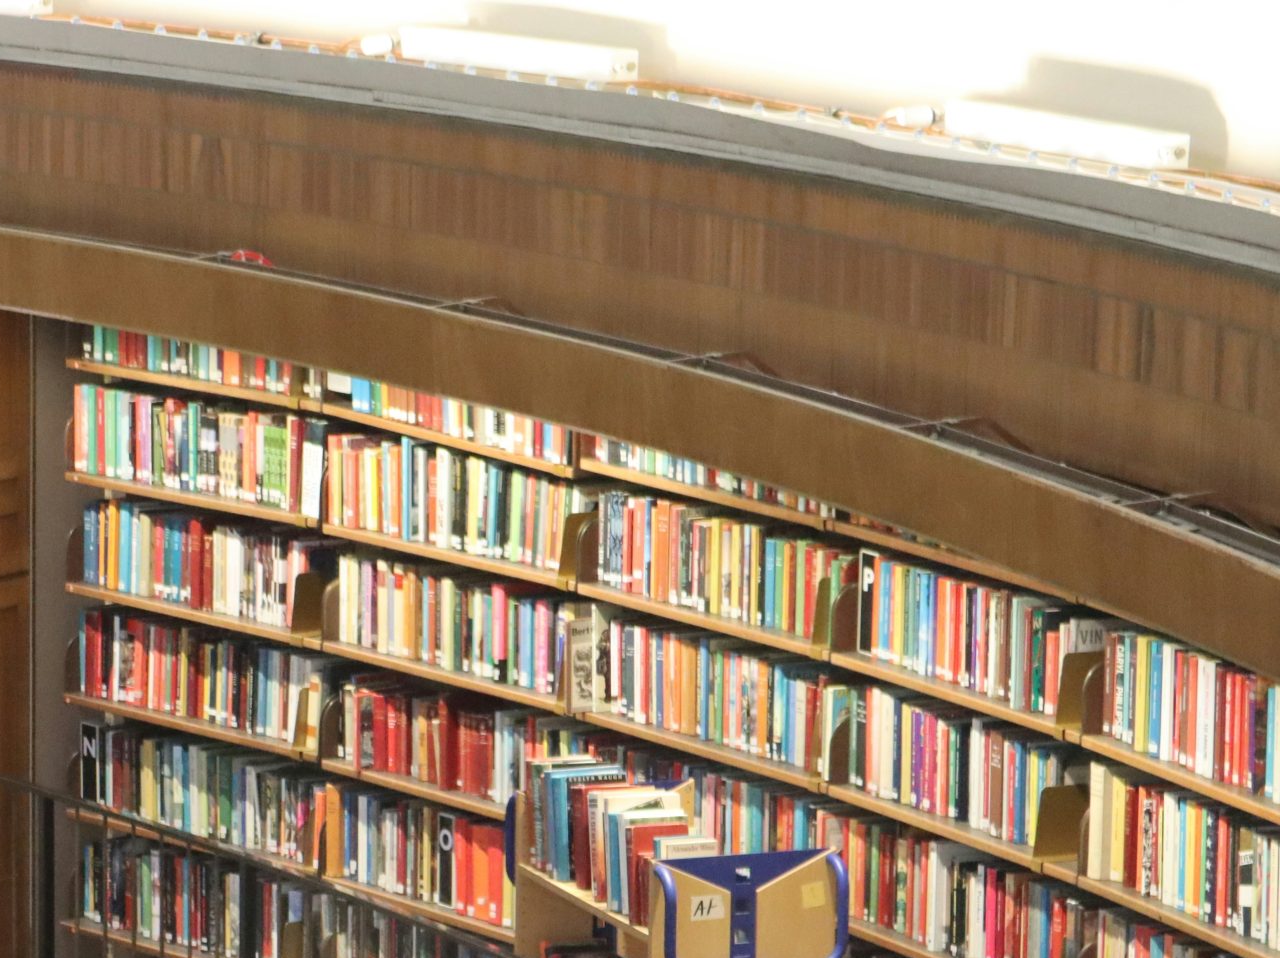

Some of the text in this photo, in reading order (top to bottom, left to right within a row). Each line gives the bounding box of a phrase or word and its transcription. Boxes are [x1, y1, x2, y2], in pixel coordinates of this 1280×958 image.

[863, 566, 874, 591] P
[1080, 629, 1103, 645] VIN
[83, 736, 96, 758] N
[569, 774, 623, 783] EVELYN WAUGH
[439, 828, 453, 851] O
